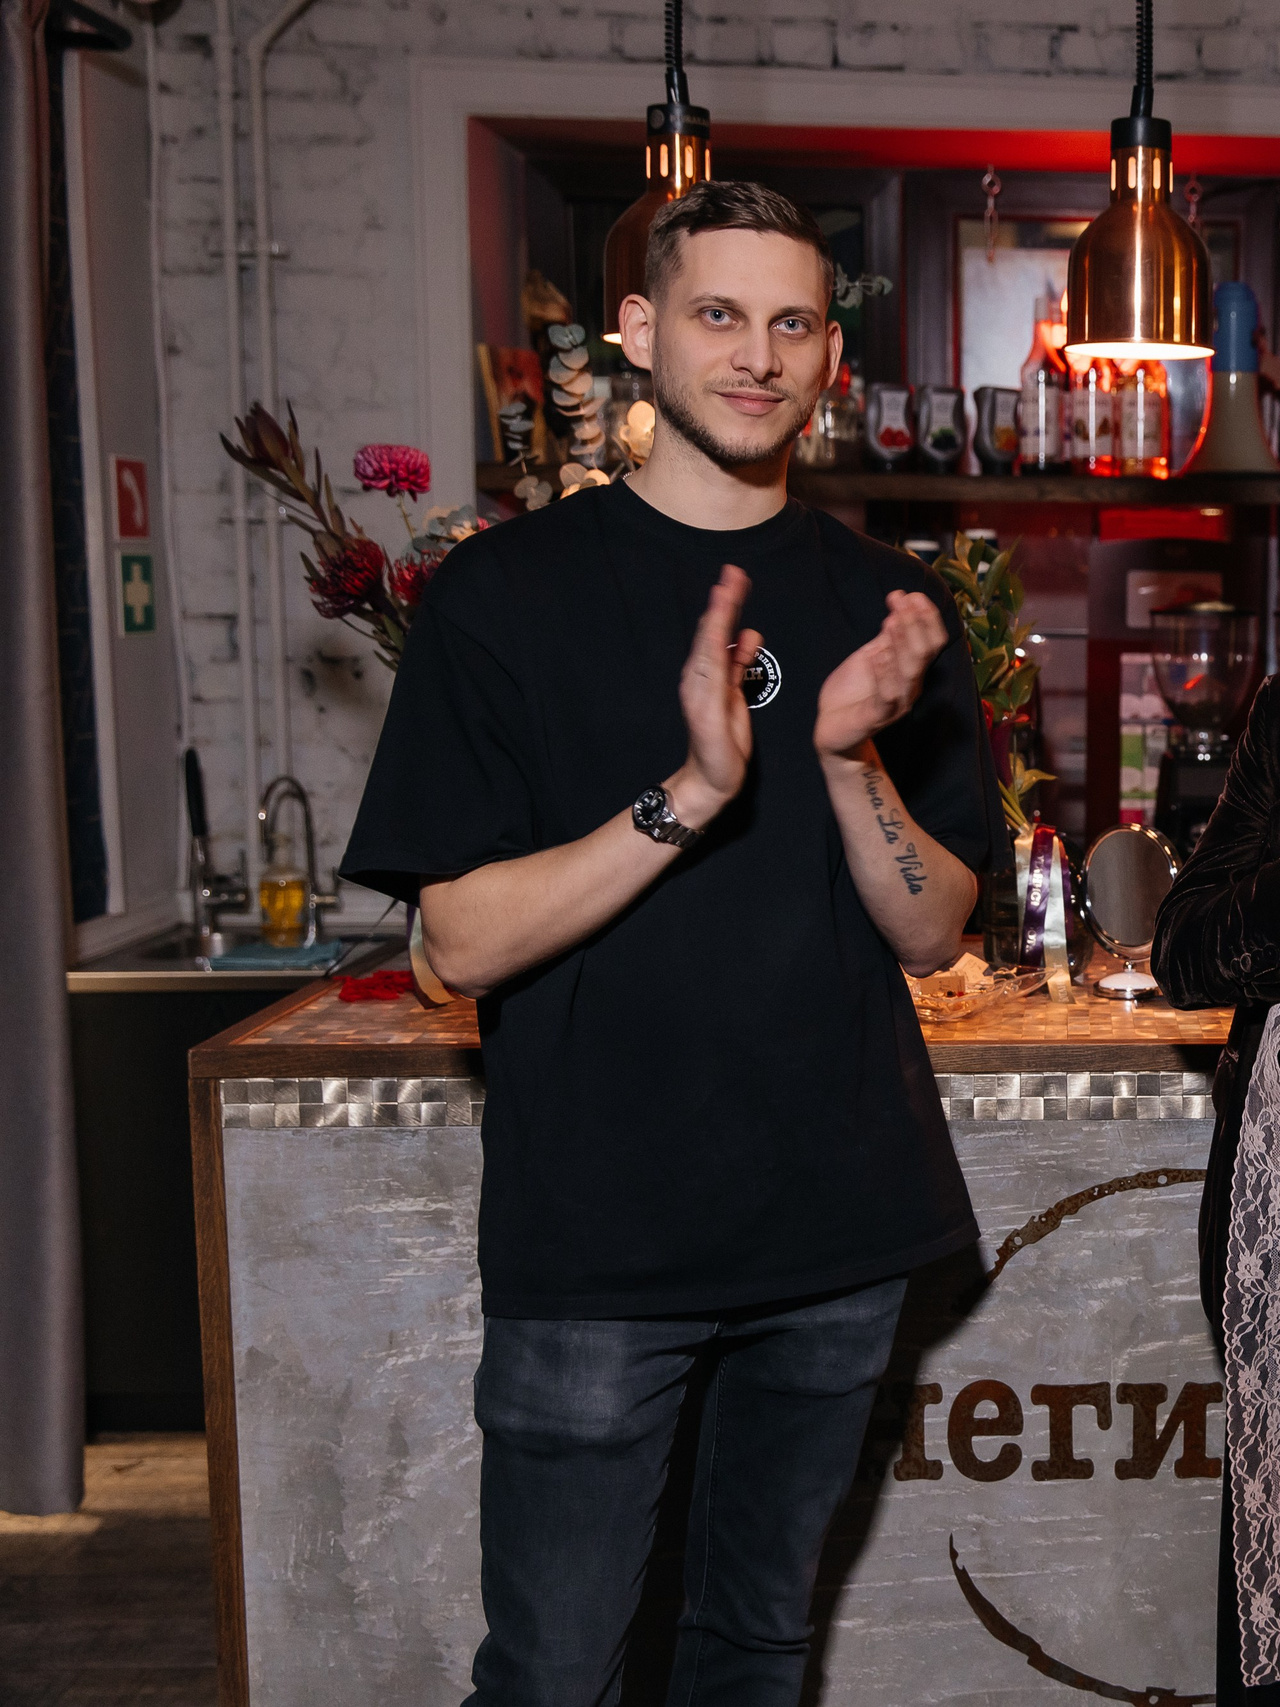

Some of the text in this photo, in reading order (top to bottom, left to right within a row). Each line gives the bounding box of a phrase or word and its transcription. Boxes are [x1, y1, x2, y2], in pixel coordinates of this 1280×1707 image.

[754, 651, 777, 702] РЕПКИЙ КОФЕ
[862, 764, 928, 896] Viva La Vida
[886, 1379, 1223, 1482] неги
